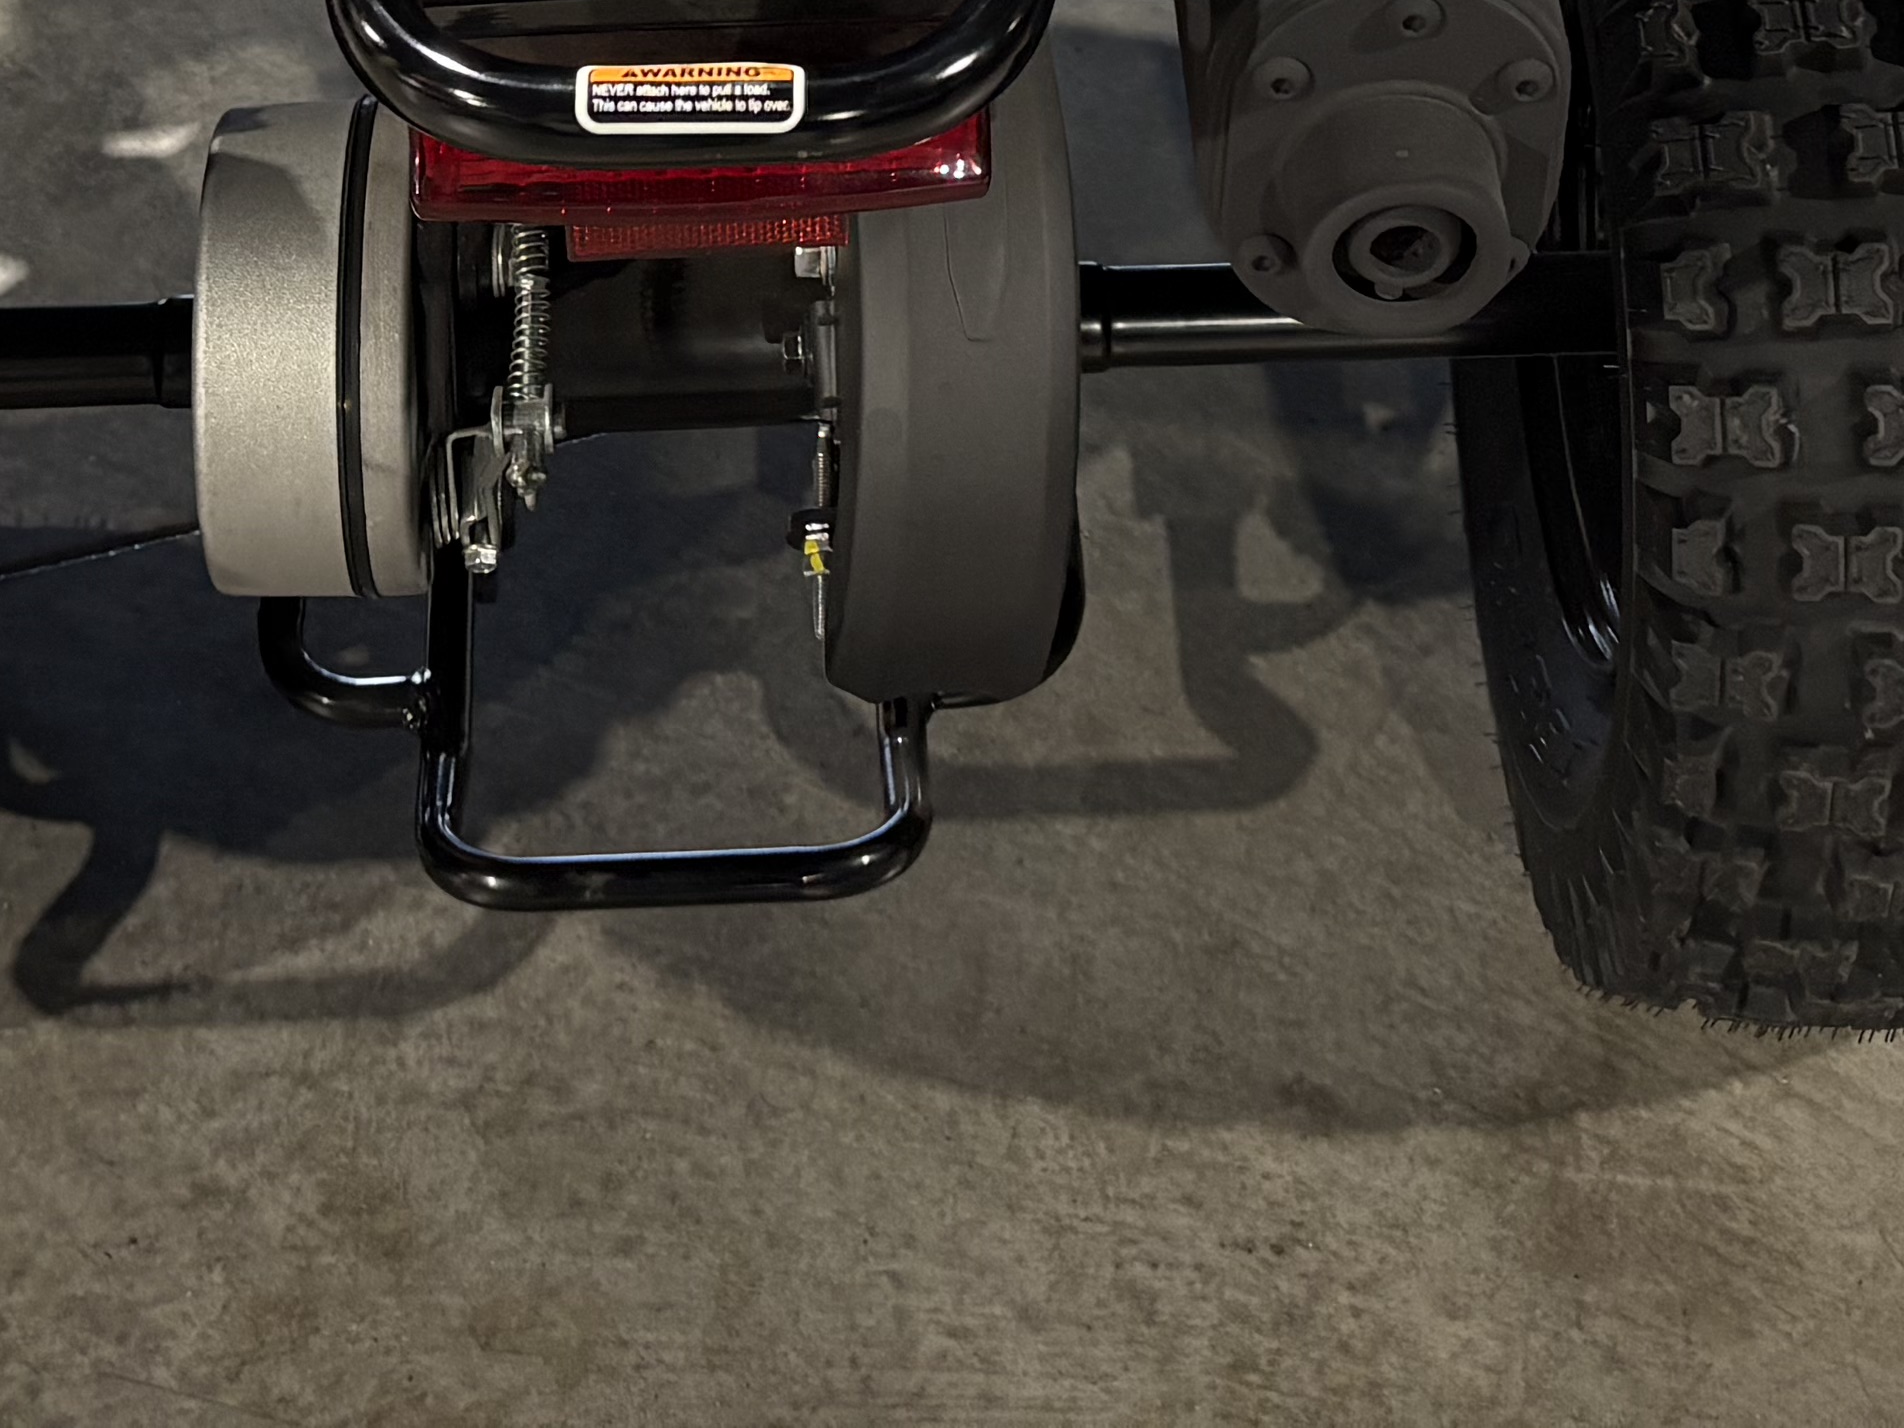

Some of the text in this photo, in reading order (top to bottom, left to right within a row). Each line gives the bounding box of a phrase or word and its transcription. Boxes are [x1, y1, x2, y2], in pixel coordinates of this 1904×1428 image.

[641, 66, 762, 78] WARNING
[592, 84, 634, 96] NEVER
[636, 84, 669, 96] attach
[670, 84, 697, 96] here
[698, 84, 710, 96] to
[712, 83, 733, 97] pull
[743, 83, 771, 96] load.
[592, 99, 616, 112] This
[617, 101, 638, 112] can
[639, 101, 673, 113] cause
[674, 99, 693, 112] the
[695, 98, 733, 112] vehicle
[734, 99, 747, 112] to
[748, 99, 763, 114] tip
